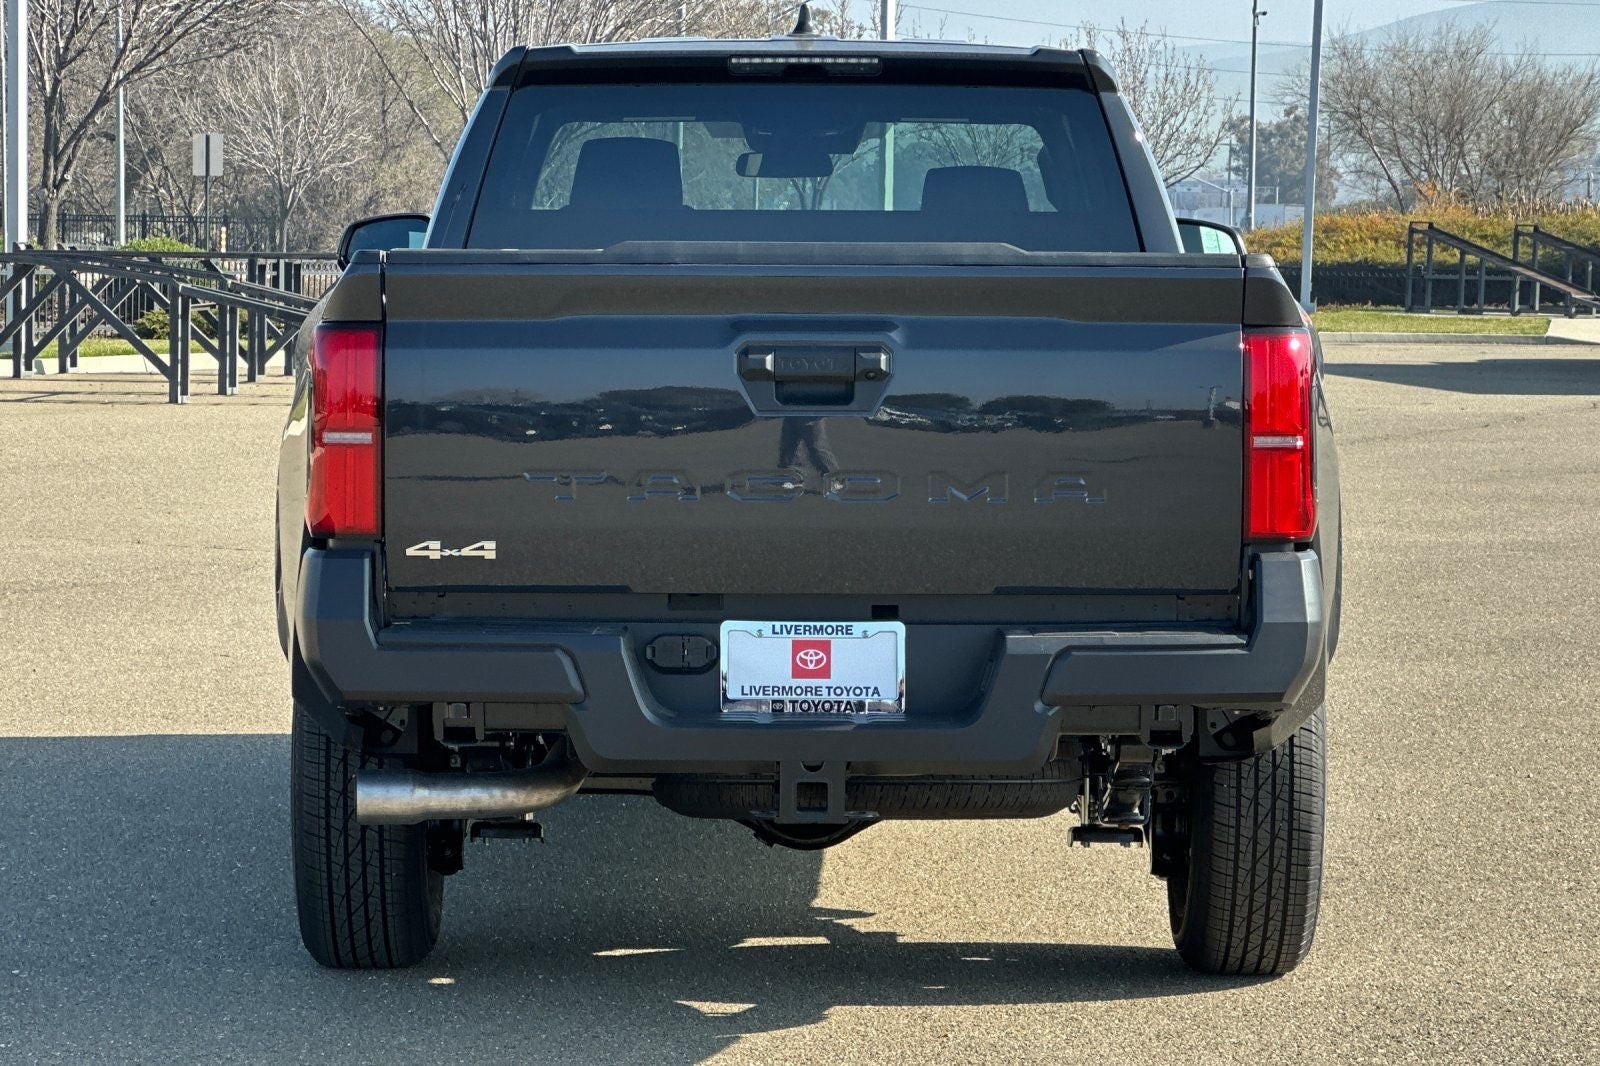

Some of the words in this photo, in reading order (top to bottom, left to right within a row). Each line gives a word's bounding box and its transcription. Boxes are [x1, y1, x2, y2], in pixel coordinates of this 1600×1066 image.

[778, 357, 850, 370] TOYOT
[522, 469, 1107, 503] TACOMA
[771, 624, 853, 636] LIVERMORE
[741, 685, 823, 697] LIVERMORE
[826, 686, 881, 697] TOYOTA
[789, 700, 855, 713] TOYOTA
